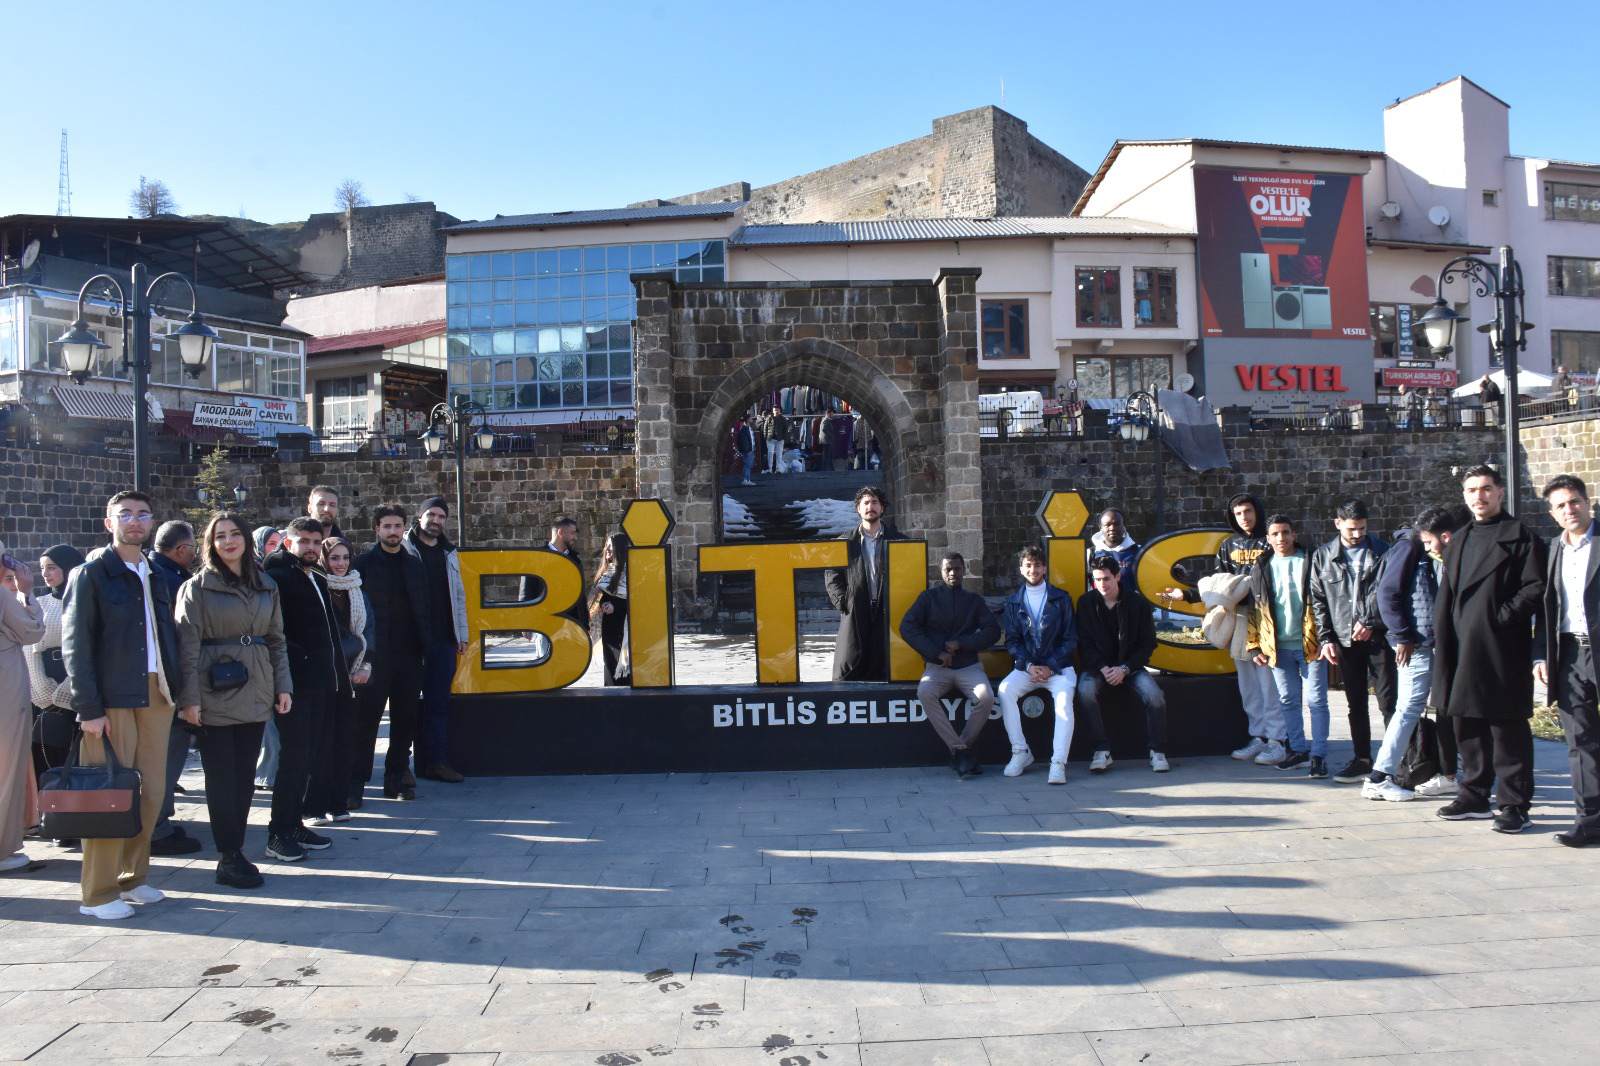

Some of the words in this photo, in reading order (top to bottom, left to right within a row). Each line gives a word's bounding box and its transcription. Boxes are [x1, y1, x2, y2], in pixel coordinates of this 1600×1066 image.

[1250, 194, 1312, 217] OLUR
[1342, 327, 1367, 336] VESTEL
[1235, 363, 1350, 393] VESTEL
[1385, 371, 1413, 379] TURKISH
[1413, 372, 1441, 380] AIRLINES
[200, 405, 227, 416] MODA
[194, 416, 213, 424] BAYAN
